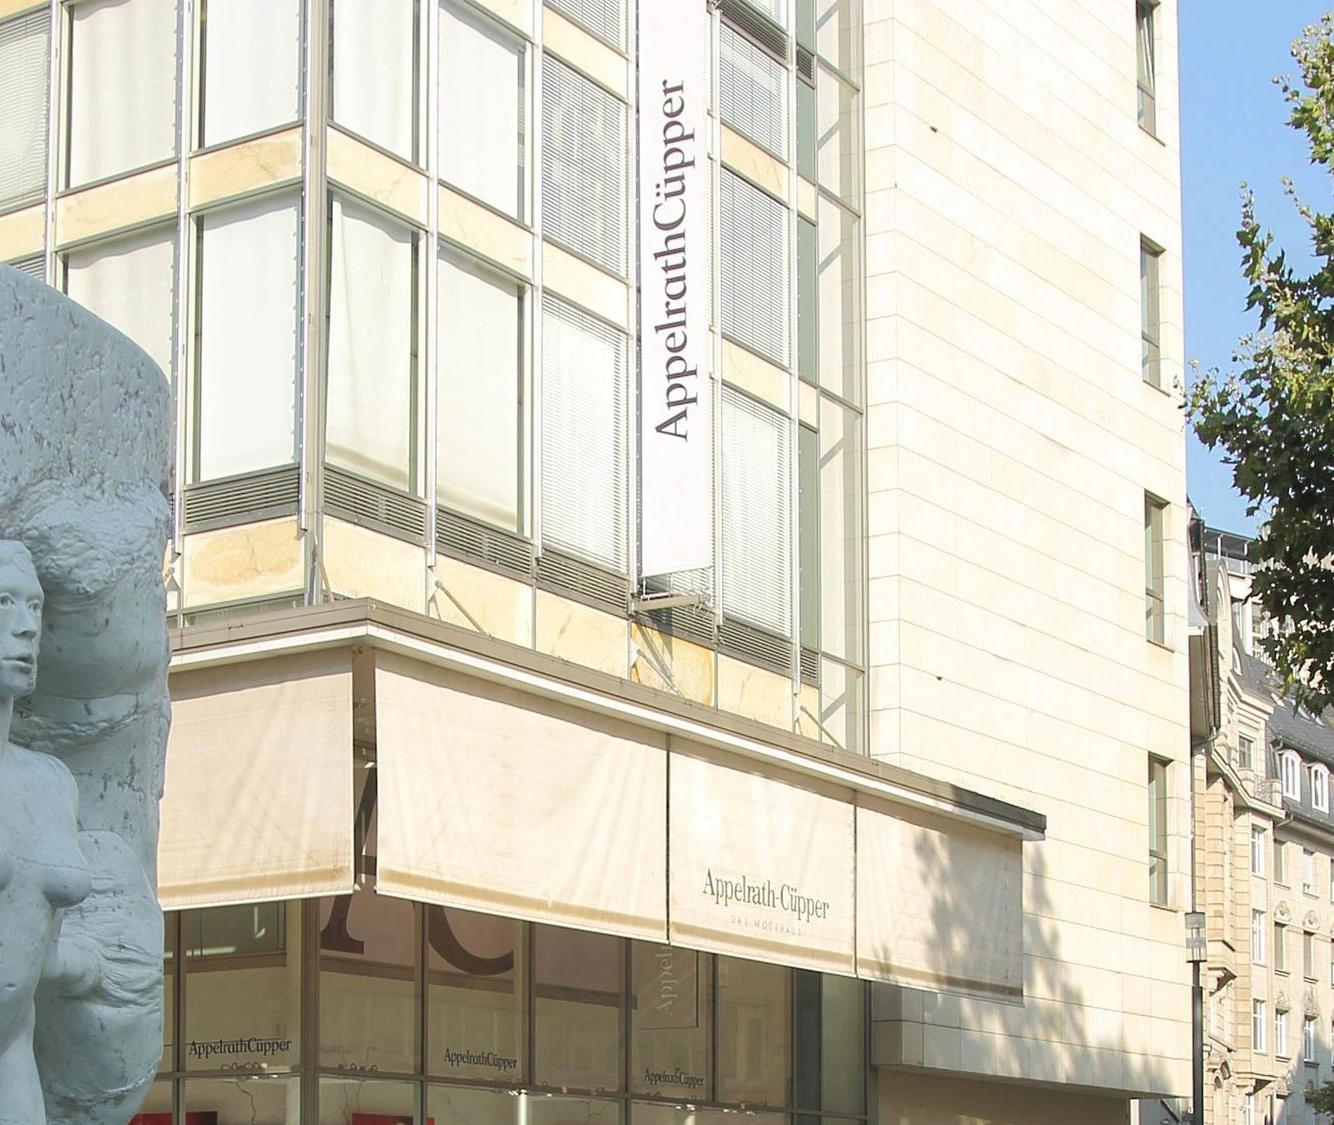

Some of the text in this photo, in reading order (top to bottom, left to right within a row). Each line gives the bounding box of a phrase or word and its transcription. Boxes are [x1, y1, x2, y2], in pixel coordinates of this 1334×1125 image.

[652, 78, 698, 443] AppelrathCüpper
[703, 867, 829, 922] Appelrath-Cüpper
[188, 1037, 292, 1059] AppelrathCüpper
[444, 1048, 518, 1071] AppelrathCüpper
